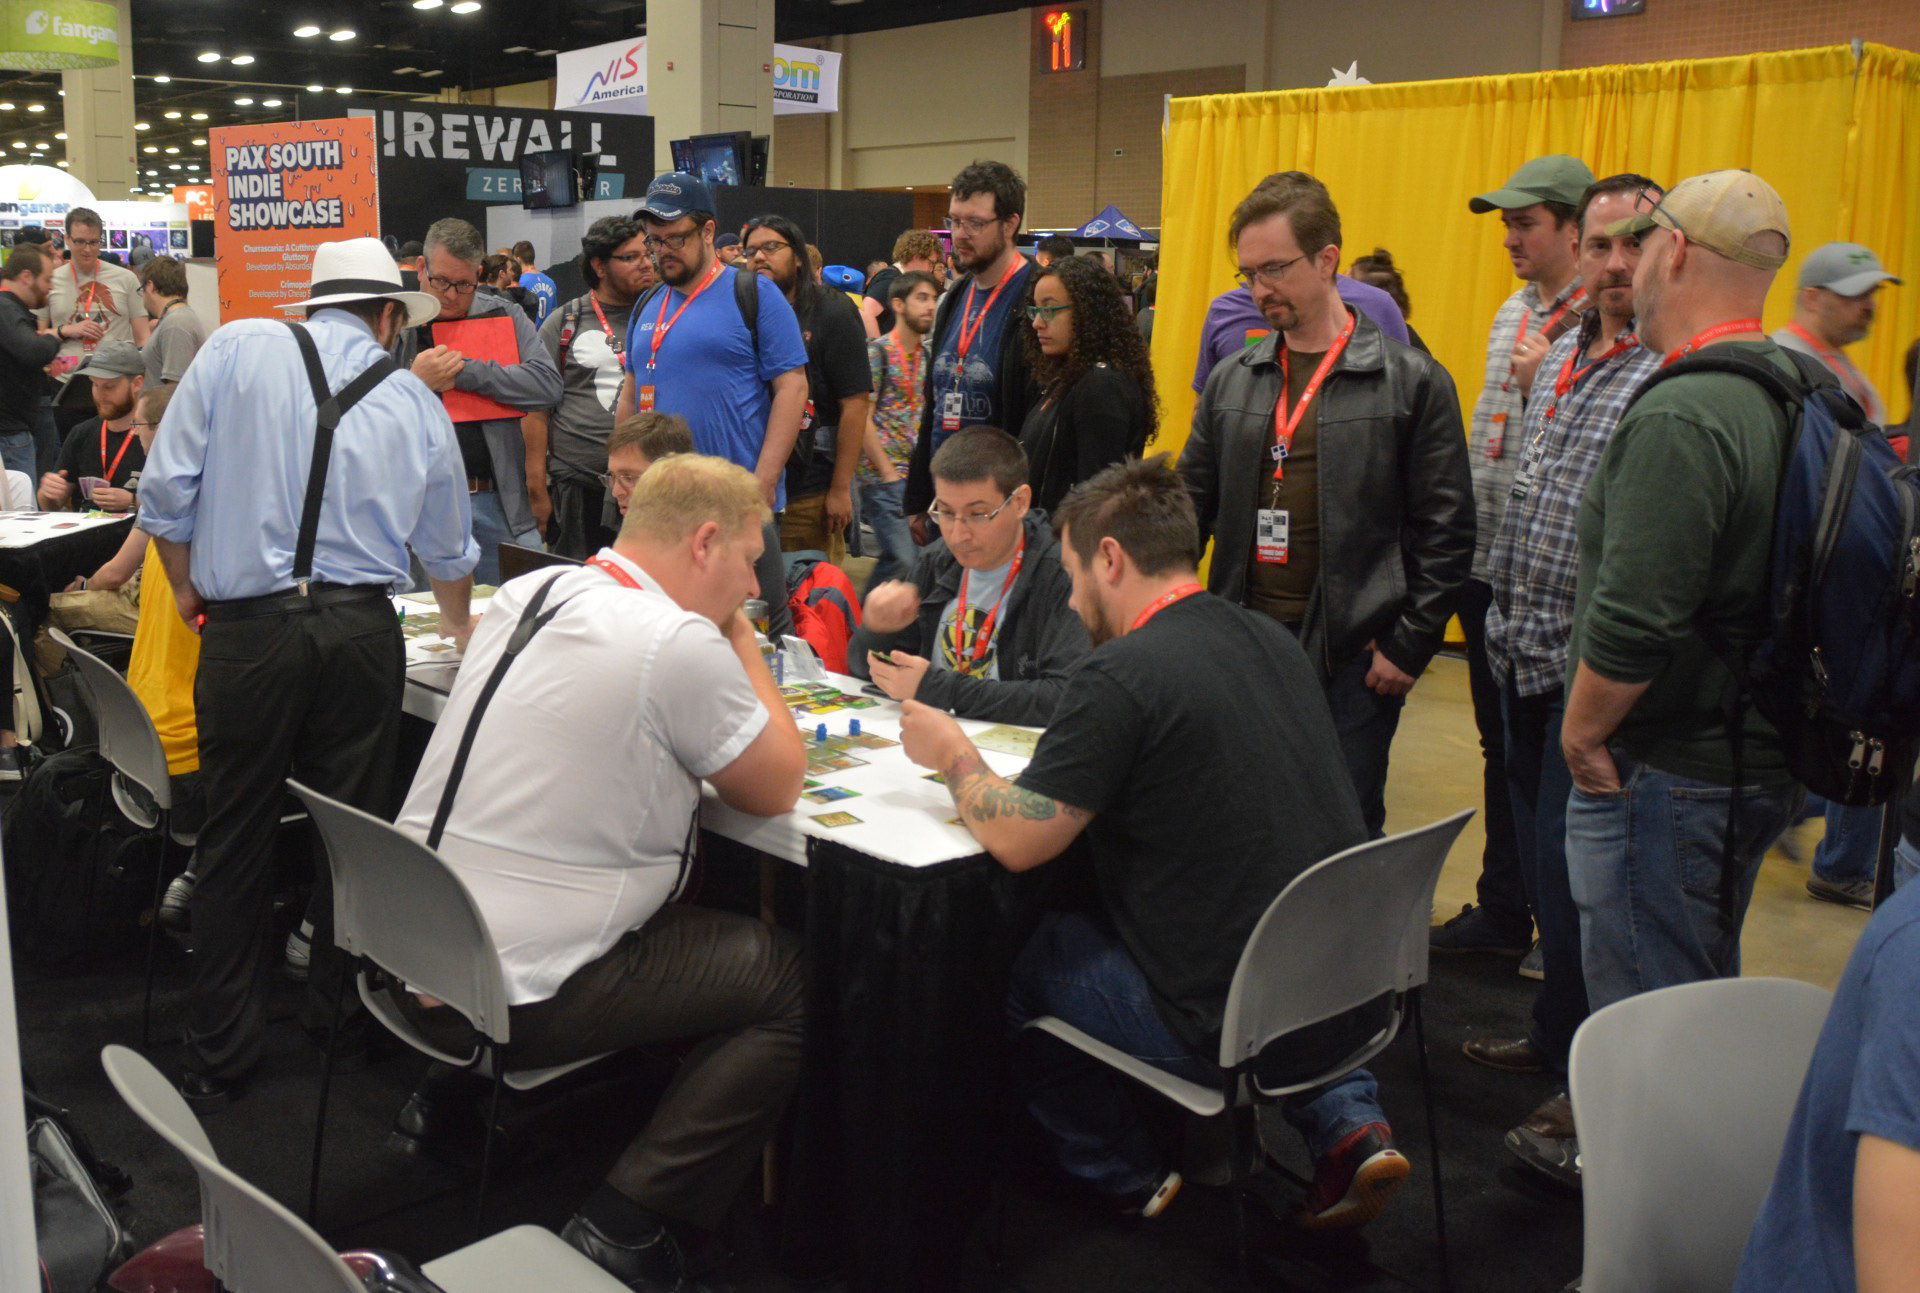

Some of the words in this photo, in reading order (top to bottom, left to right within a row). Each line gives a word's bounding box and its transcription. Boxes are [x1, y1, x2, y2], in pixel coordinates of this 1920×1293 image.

[576, 41, 645, 105] NIS
[592, 84, 645, 101] America
[774, 89, 816, 102] RPORATION
[226, 146, 266, 171] PAX
[269, 139, 341, 170] SOUTH
[227, 173, 282, 199] INDIE
[482, 176, 523, 193] ZER
[0, 202, 70, 217] angamer
[228, 199, 342, 228] SHOWCASE
[282, 253, 310, 262] Gluttony
[246, 263, 276, 272] Developed
[277, 262, 285, 272] by
[280, 280, 311, 290] Crimopoli
[249, 290, 279, 299] Developed
[279, 289, 287, 299] by
[288, 289, 307, 299] Cheap
